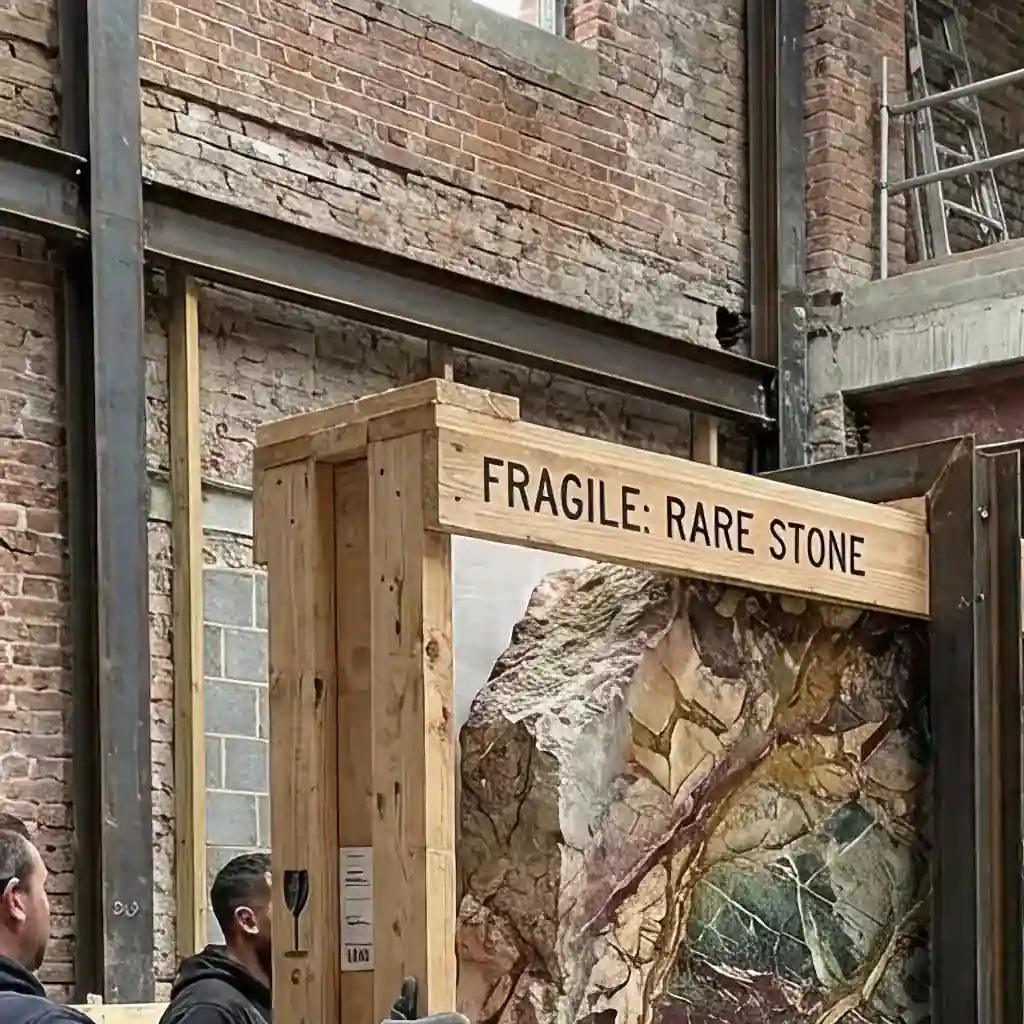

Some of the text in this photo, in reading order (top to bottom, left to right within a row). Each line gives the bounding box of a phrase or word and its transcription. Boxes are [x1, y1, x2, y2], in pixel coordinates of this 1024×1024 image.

[483, 456, 866, 577] FRAGILE: RARE STONE
